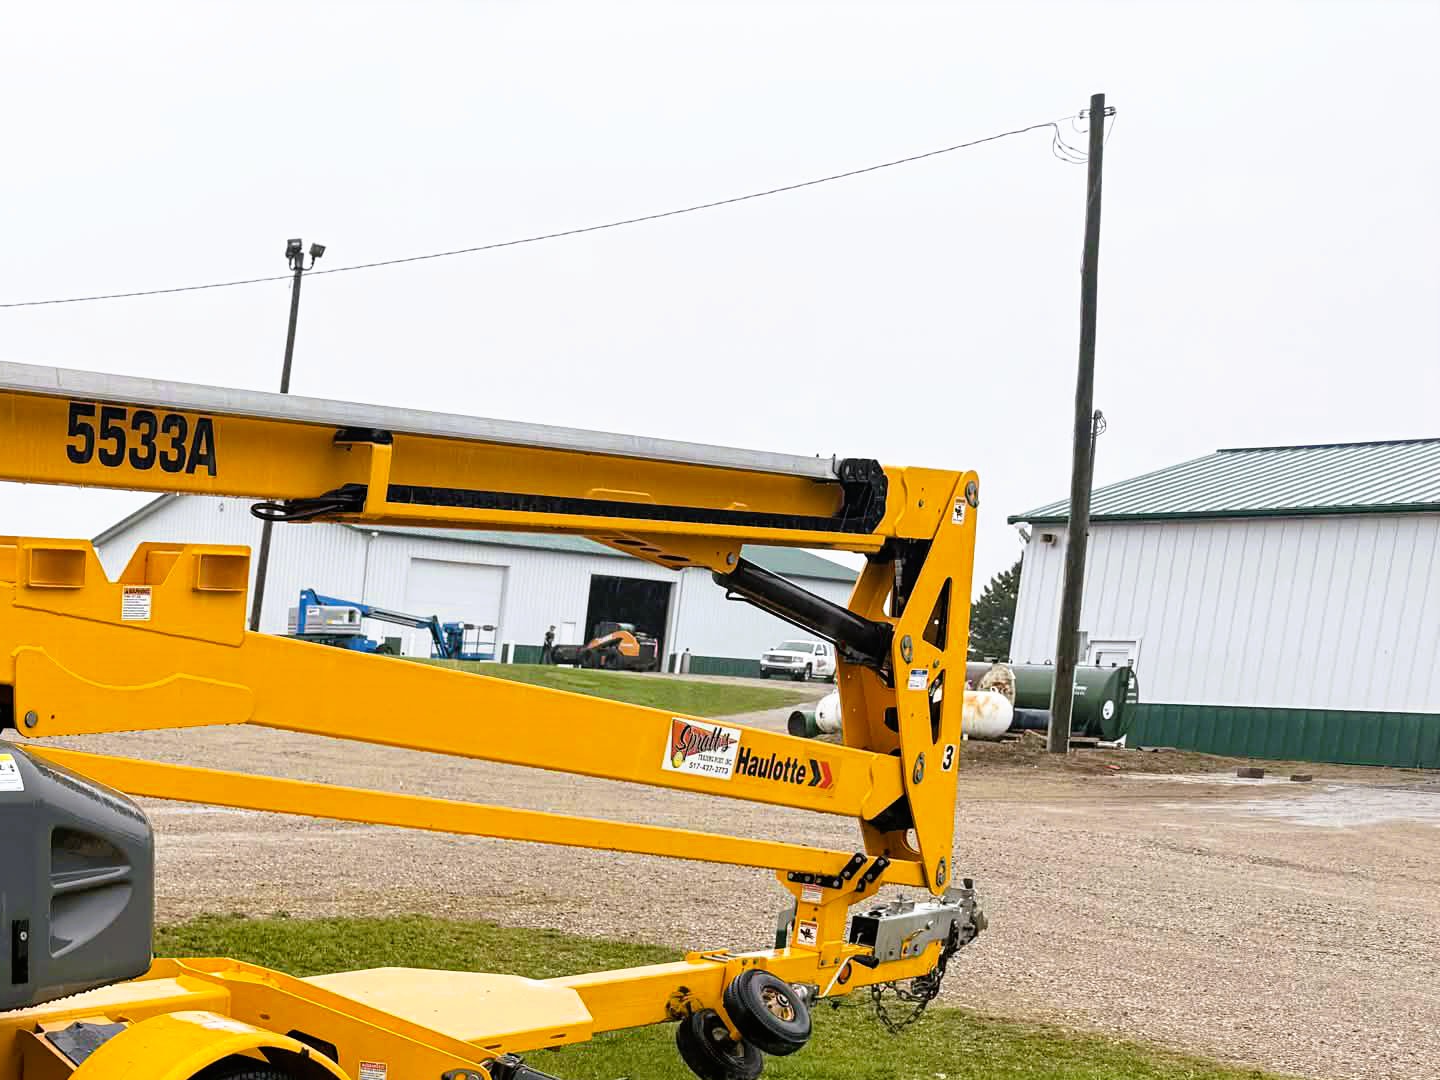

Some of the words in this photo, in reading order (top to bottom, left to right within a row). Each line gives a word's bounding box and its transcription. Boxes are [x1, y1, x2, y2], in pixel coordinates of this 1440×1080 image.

[66, 402, 217, 476] 5533A
[735, 746, 807, 785] Haulotte
[942, 745, 954, 770] 3
